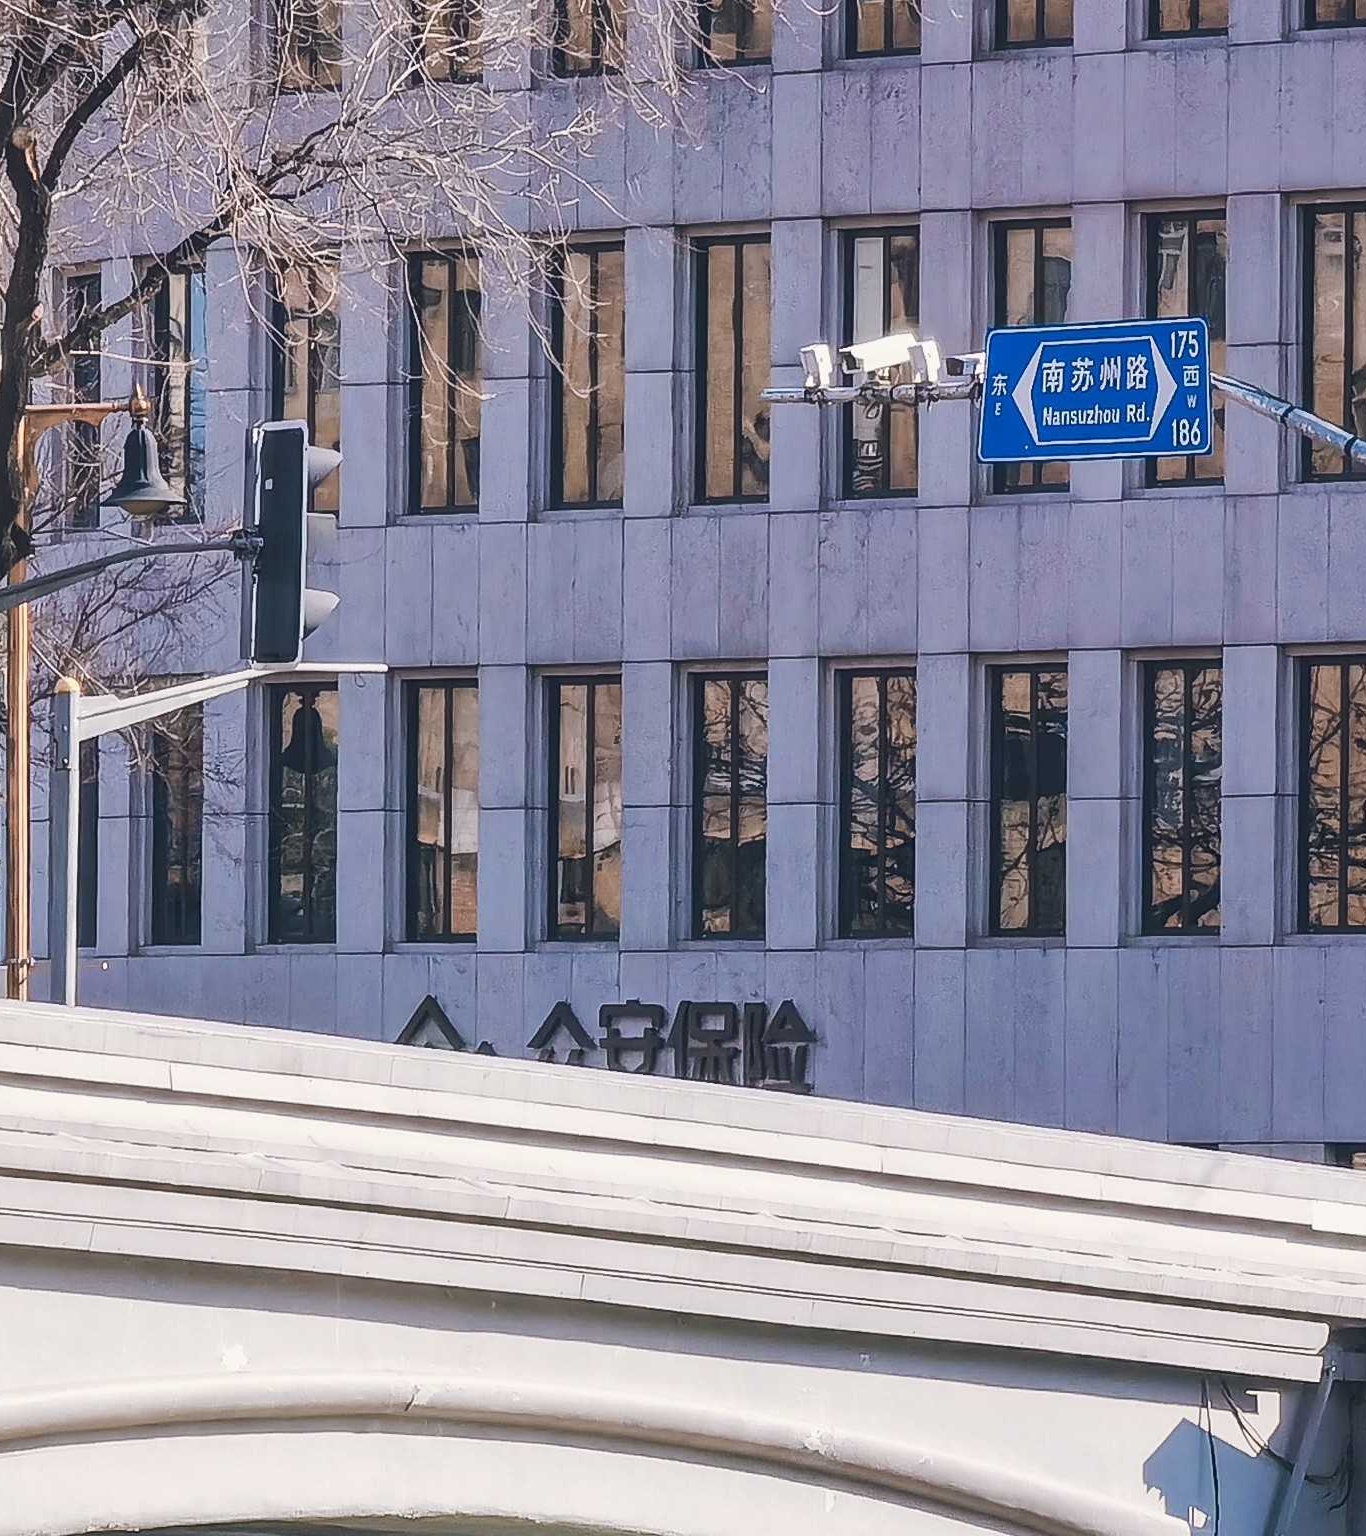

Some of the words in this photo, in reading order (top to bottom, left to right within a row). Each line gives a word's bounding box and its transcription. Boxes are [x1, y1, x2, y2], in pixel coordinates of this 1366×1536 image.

[1170, 330, 1199, 359] 175
[991, 374, 1008, 396] 东
[1041, 354, 1149, 393] 南苏州路
[1182, 365, 1200, 387] 西
[994, 402, 1002, 416] E
[1186, 394, 1197, 409] W
[1042, 404, 1120, 426] Nansuzhou
[1126, 401, 1150, 423] Rd.
[1172, 418, 1201, 447] 186
